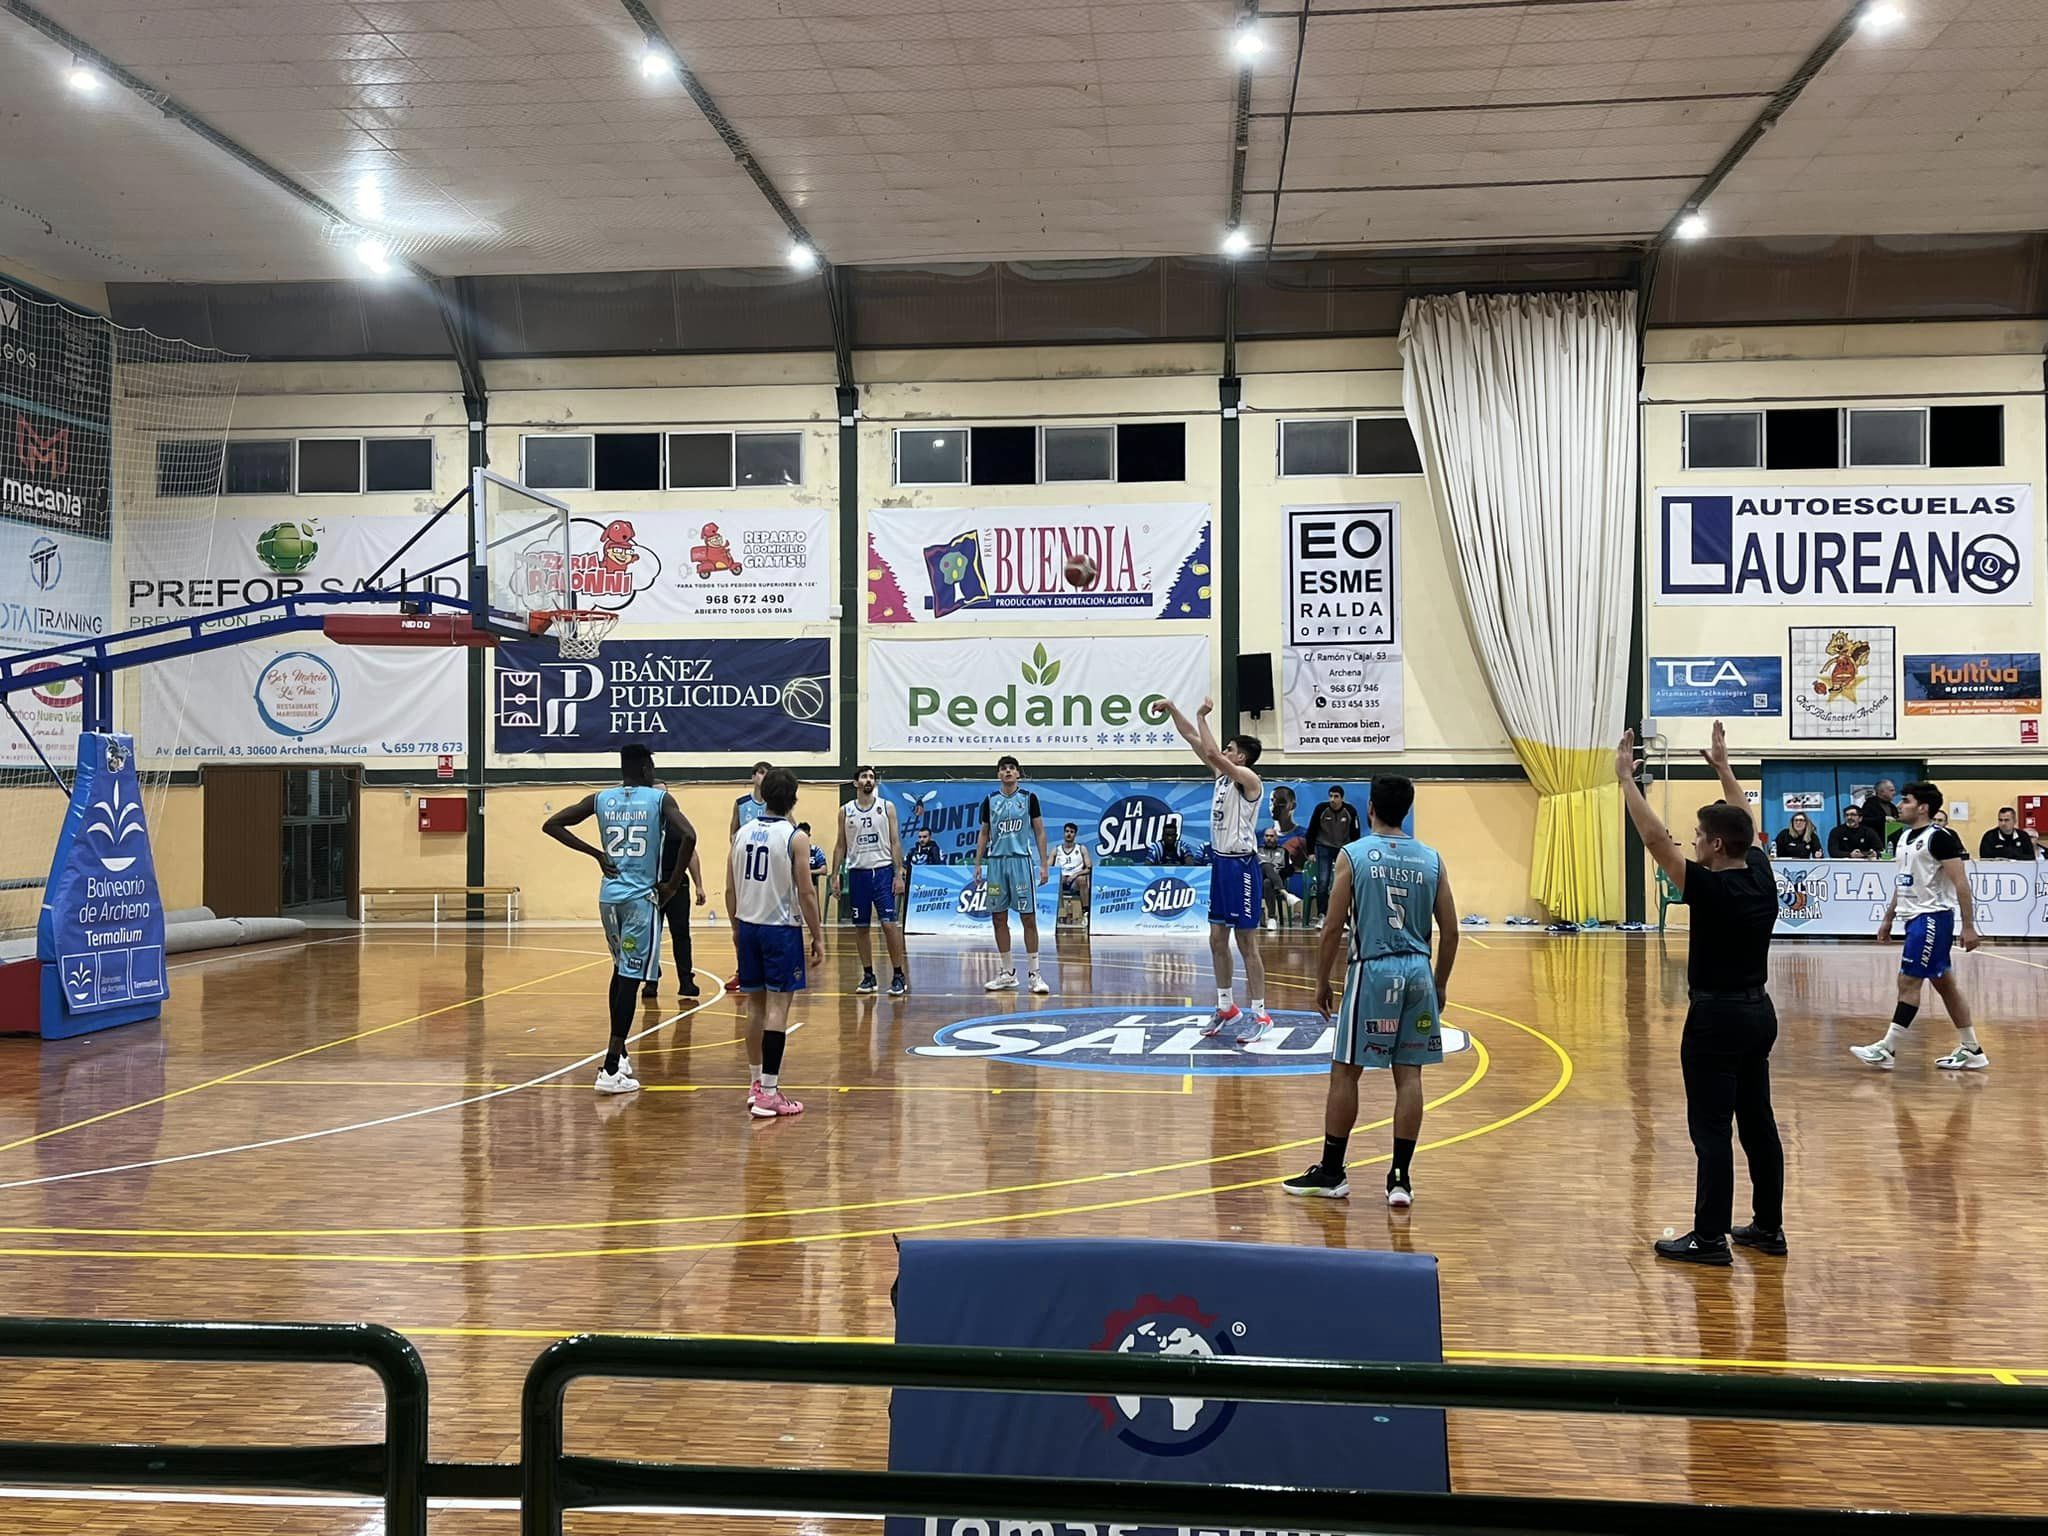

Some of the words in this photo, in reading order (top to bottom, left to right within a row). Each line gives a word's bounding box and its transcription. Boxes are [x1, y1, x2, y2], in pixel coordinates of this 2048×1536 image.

[2, 343, 37, 368] GOS
[3, 478, 81, 517] mecania
[1736, 496, 2016, 516] AUTOESCUELAS
[744, 531, 807, 544] REPARTO
[984, 528, 992, 557] FRUTAS
[1300, 519, 1382, 559] EO
[744, 545, 750, 554] A
[754, 544, 806, 554] DOMICILIO
[527, 552, 600, 570] PIZZRIA
[744, 554, 807, 568] GRATIS!!
[994, 525, 1138, 594] BUENDIA
[1300, 569, 1383, 594] ESME
[129, 579, 304, 607] PREFOR
[706, 595, 729, 604] 968
[733, 594, 757, 604] 672
[761, 594, 785, 604] 490
[996, 597, 1047, 607] PRODUCCION
[1048, 598, 1052, 606] Y
[1054, 596, 1106, 606] EXPORTACION
[1107, 596, 1145, 605] AGRICOLA
[1300, 601, 1383, 618] RALDA
[1301, 625, 1384, 637] OPTICA
[1317, 652, 1345, 661] Ramón
[1347, 654, 1352, 662] y
[1376, 652, 1386, 660] 53
[609, 652, 714, 682] IBÁÑEZ
[1329, 669, 1361, 677] Archena
[1656, 660, 1748, 687] TCA
[1930, 658, 2018, 684] Kultiva
[609, 685, 781, 708] PUBLICIDAD
[1363, 684, 1379, 692] 946
[1945, 686, 2004, 694] agrocentros
[908, 684, 1173, 727] Pedaneo
[1332, 700, 1346, 708] 633
[1348, 700, 1363, 708] 454
[1364, 700, 1380, 708] 335
[609, 711, 668, 733] FHA
[1304, 721, 1316, 729] Te
[1318, 720, 1358, 729] miramos
[394, 743, 415, 753] 659
[418, 742, 439, 752] 778
[442, 742, 463, 752] 673
[908, 736, 952, 744] FROZEN
[958, 735, 1031, 744] VEGETABLES
[1035, 735, 1043, 744] &
[1048, 735, 1089, 743] FRUITS
[1300, 736, 1320, 745] para
[1322, 736, 1339, 745] que
[1340, 735, 1361, 743] veas
[1363, 734, 1390, 744] mejor
[156, 747, 172, 756] Av.
[175, 746, 191, 756] del
[194, 746, 226, 756] Carril,
[229, 746, 244, 756] 43,
[247, 745, 277, 755] 30600
[280, 744, 327, 756] Archena,
[330, 744, 368, 754] Murcia
[1125, 801, 1143, 818] LA
[860, 817, 873, 828] 73
[901, 802, 984, 839] #JUNT
[998, 819, 1023, 834] SALUD
[605, 825, 648, 857] 25
[1096, 812, 1184, 856] SALUD
[745, 844, 769, 881] 10
[1370, 865, 1424, 884] BALESTA
[87, 875, 145, 898] Balneario
[1159, 880, 1172, 890] LA
[1834, 872, 1887, 901] LA
[916, 901, 951, 912] DEPORTE
[957, 890, 988, 913] SAL
[1100, 902, 1136, 914] DEPORTE
[1141, 887, 1197, 914] SALUD
[1385, 885, 1408, 930] 5
[1777, 900, 1822, 920] RCHENA
[80, 903, 97, 924] de
[99, 901, 150, 921] Archena
[85, 928, 142, 947] Termalium
[911, 1023, 1471, 1056] SALU
